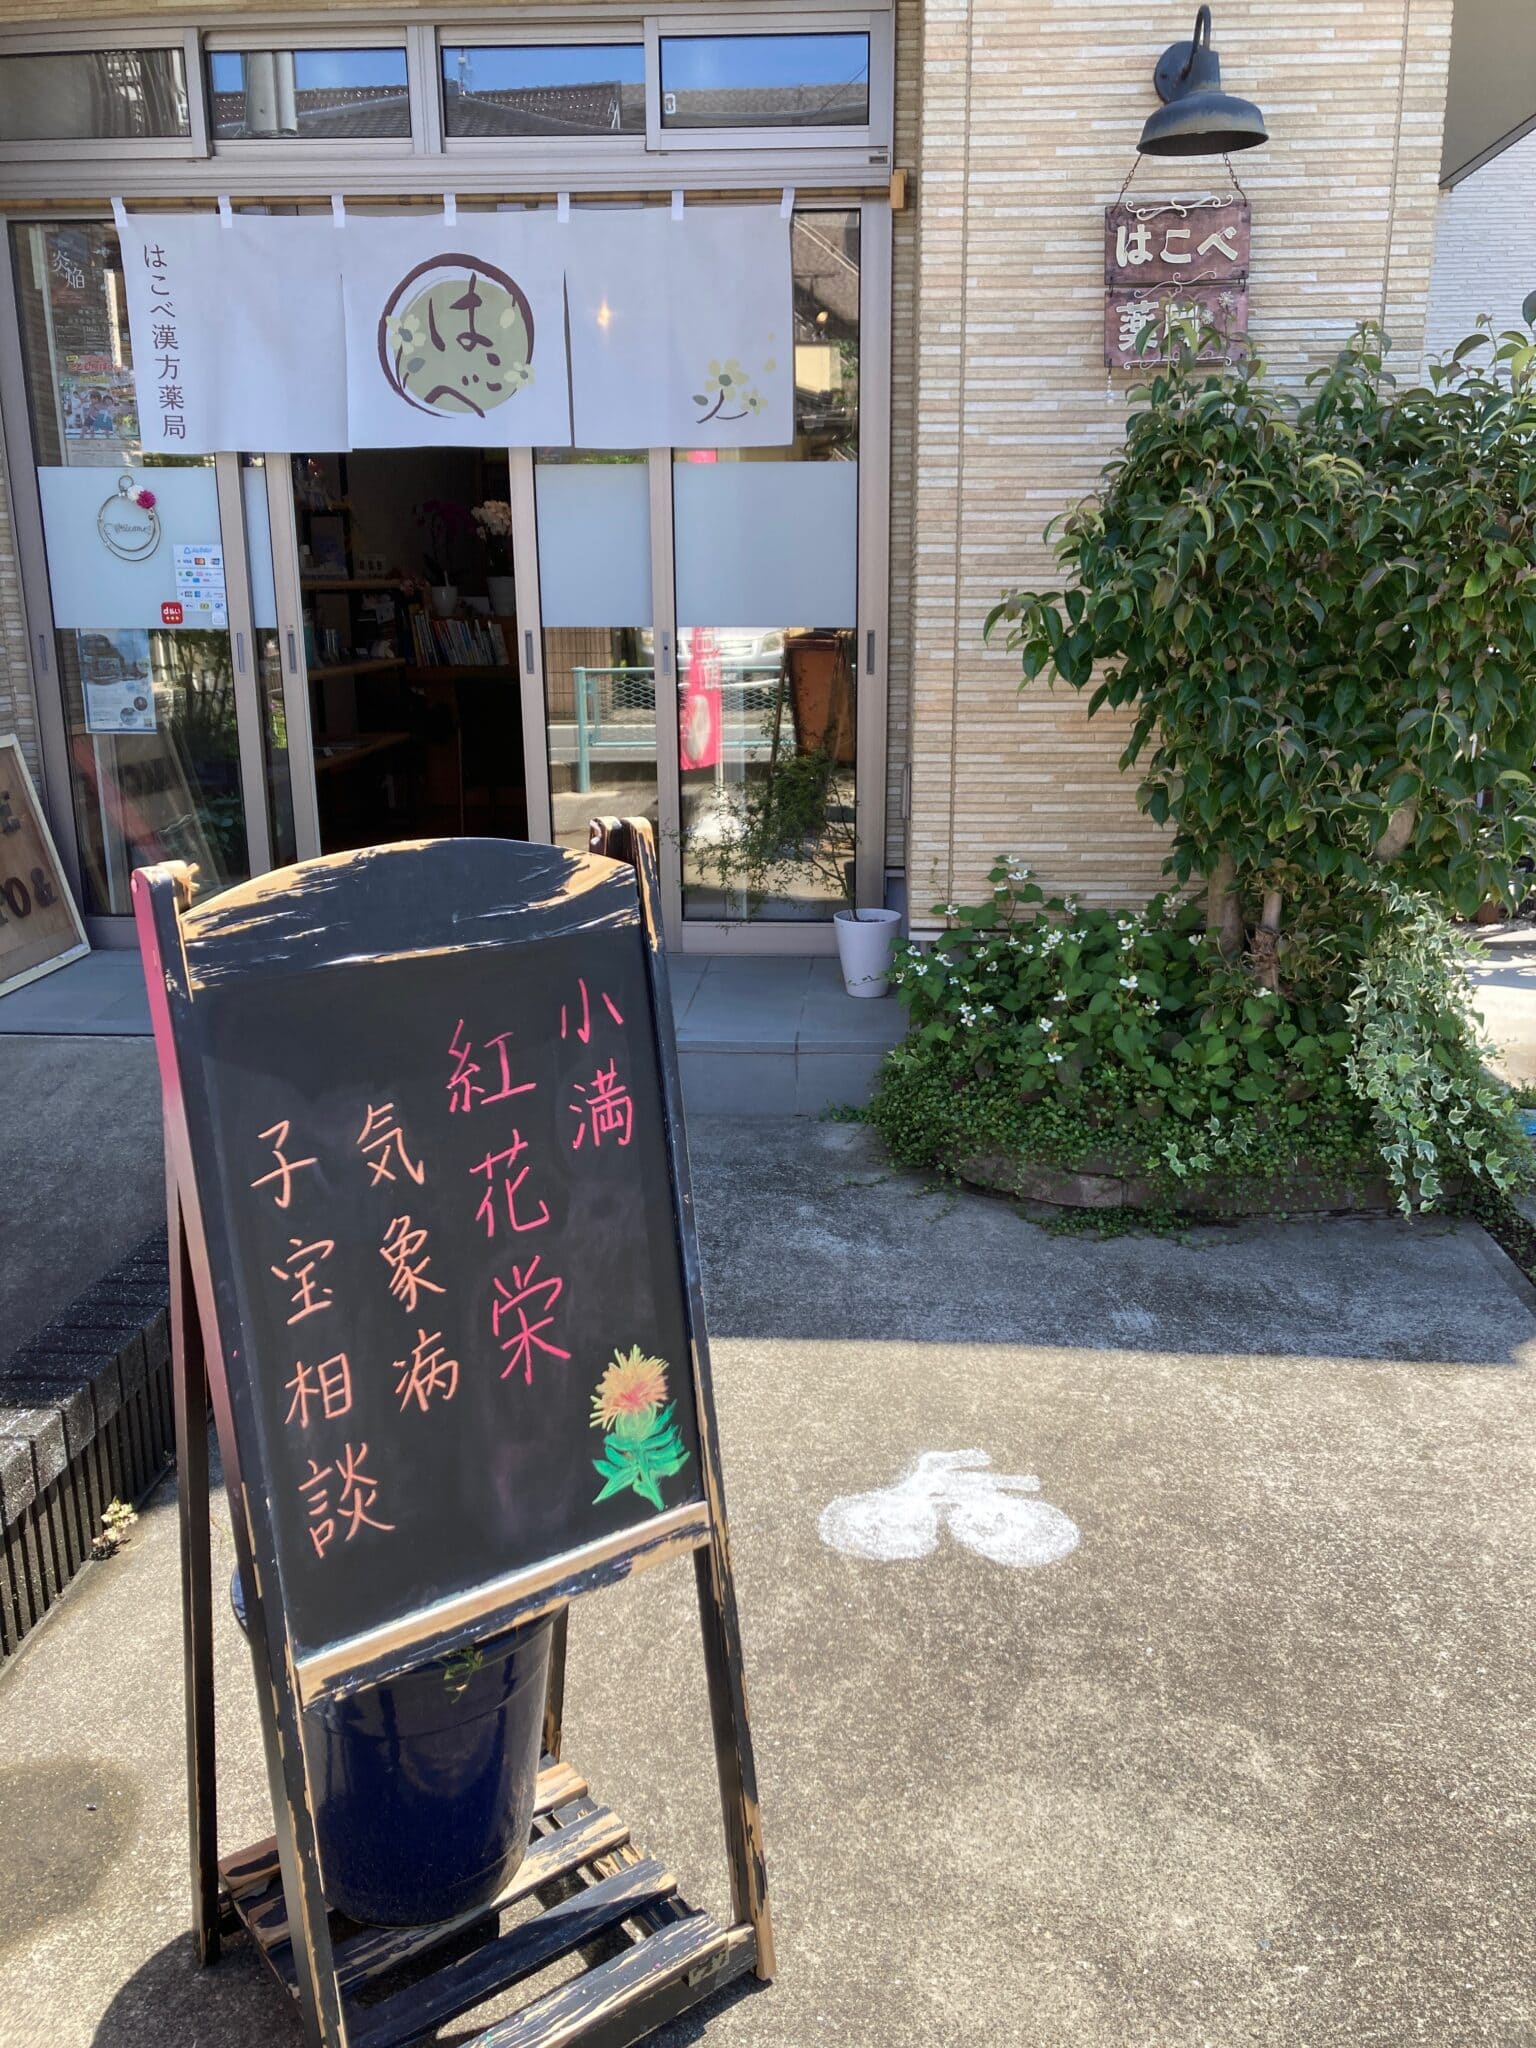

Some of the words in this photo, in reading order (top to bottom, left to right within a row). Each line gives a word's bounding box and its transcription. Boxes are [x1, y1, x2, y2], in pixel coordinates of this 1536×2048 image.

[143, 242, 187, 441] はこべ漢方薬局
[1115, 223, 1239, 268] はこべ
[560, 977, 634, 1152] 小満
[356, 1101, 461, 1414] 気象病
[447, 1018, 572, 1386] 紅花栄
[250, 1119, 396, 1560] 子宝相談
